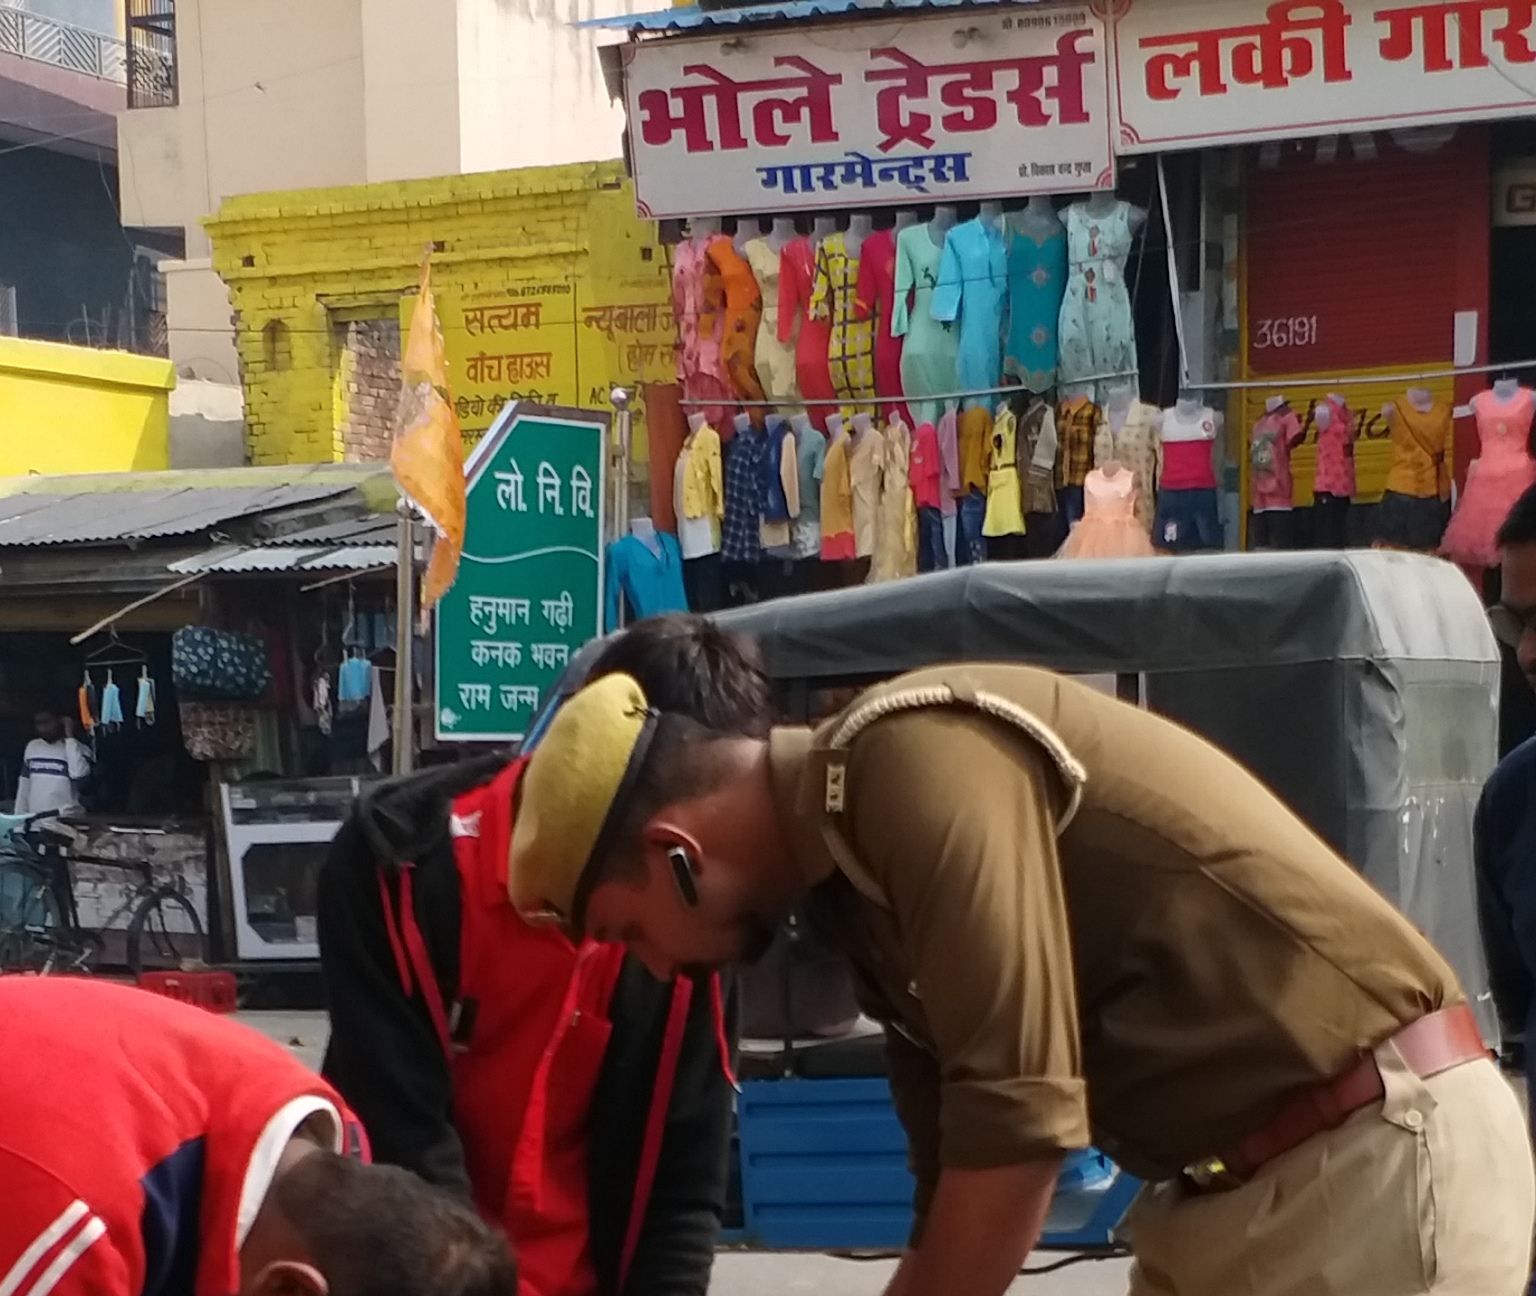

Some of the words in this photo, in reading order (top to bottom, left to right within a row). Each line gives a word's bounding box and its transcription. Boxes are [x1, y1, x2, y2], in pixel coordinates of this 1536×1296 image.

[1139, 2, 1352, 100] लकी
[638, 55, 843, 153] भोले
[863, 28, 1096, 152] ट्रेडर्स
[756, 151, 972, 194] गारमेन्ट्स
[462, 302, 543, 337] सत्यम
[1253, 316, 1318, 351] 36191
[494, 457, 527, 512] लो.
[469, 595, 531, 635] हनुमान
[540, 590, 574, 635] गढ़ी
[470, 640, 523, 669] कनक
[530, 643, 570, 670] भवन
[458, 683, 492, 711] राम
[499, 684, 540, 712] जन्म
